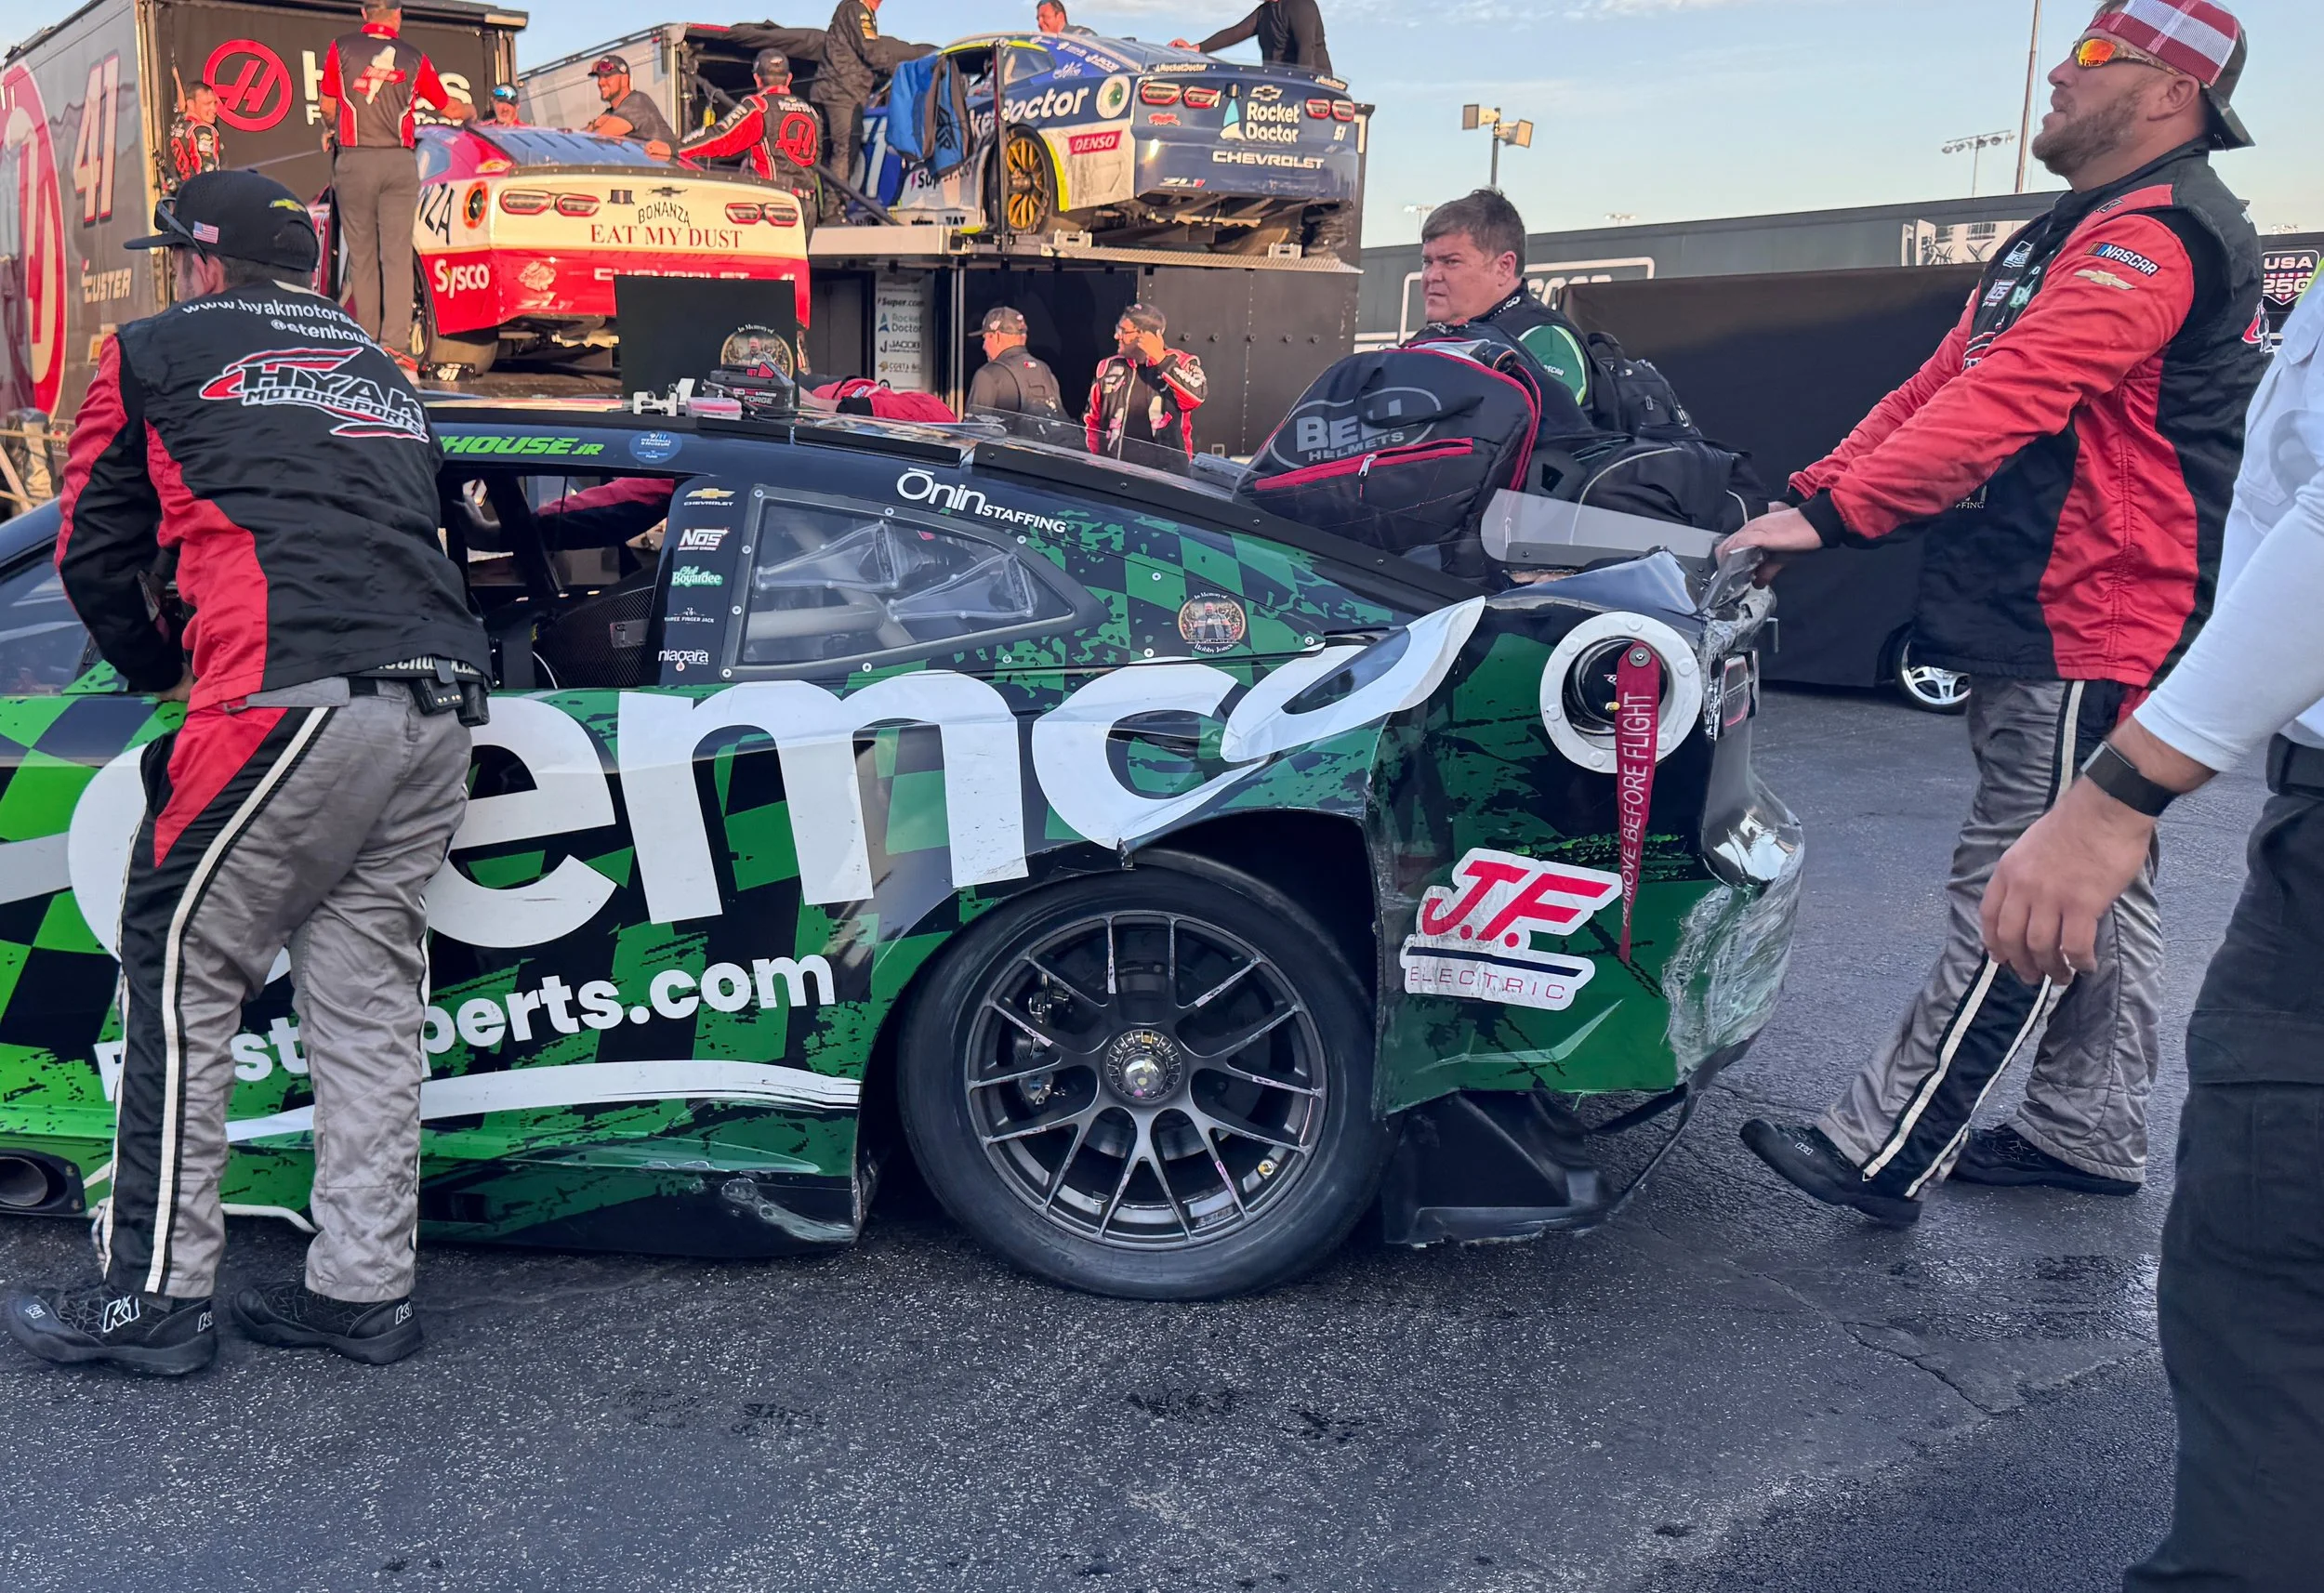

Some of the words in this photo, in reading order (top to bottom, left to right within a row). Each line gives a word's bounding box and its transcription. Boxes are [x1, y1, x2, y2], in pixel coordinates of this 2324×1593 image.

[1247, 101, 1301, 124] Rocket
[73, 53, 121, 229] 41
[1075, 135, 1116, 151] DENSO
[1246, 122, 1300, 143] Doctor
[1212, 151, 1325, 169] CHEVROLET
[638, 201, 691, 228] BONANZA
[590, 223, 643, 244] EAT
[645, 226, 684, 246] MY
[688, 227, 744, 248] DUST
[2102, 244, 2159, 276] NASCAR
[2264, 256, 2314, 270] USA
[434, 258, 491, 298] Sysco
[2263, 277, 2312, 294] 250
[182, 298, 374, 336] www.hyakmotors
[271, 319, 381, 353] @stenhous
[239, 363, 425, 424] HYAK
[242, 388, 428, 437] MOTORSPORTS
[571, 443, 604, 455] JR
[1308, 432, 1405, 462] HELMETS
[982, 504, 1067, 533] STAFFING
[679, 528, 728, 546] NOS
[671, 571, 723, 587] Boyardee
[658, 649, 709, 663] niagara
[1622, 691, 1652, 758] FLIGHT
[1622, 765, 1648, 843] BEFORE
[1410, 965, 1565, 1001] ELECTRIC
